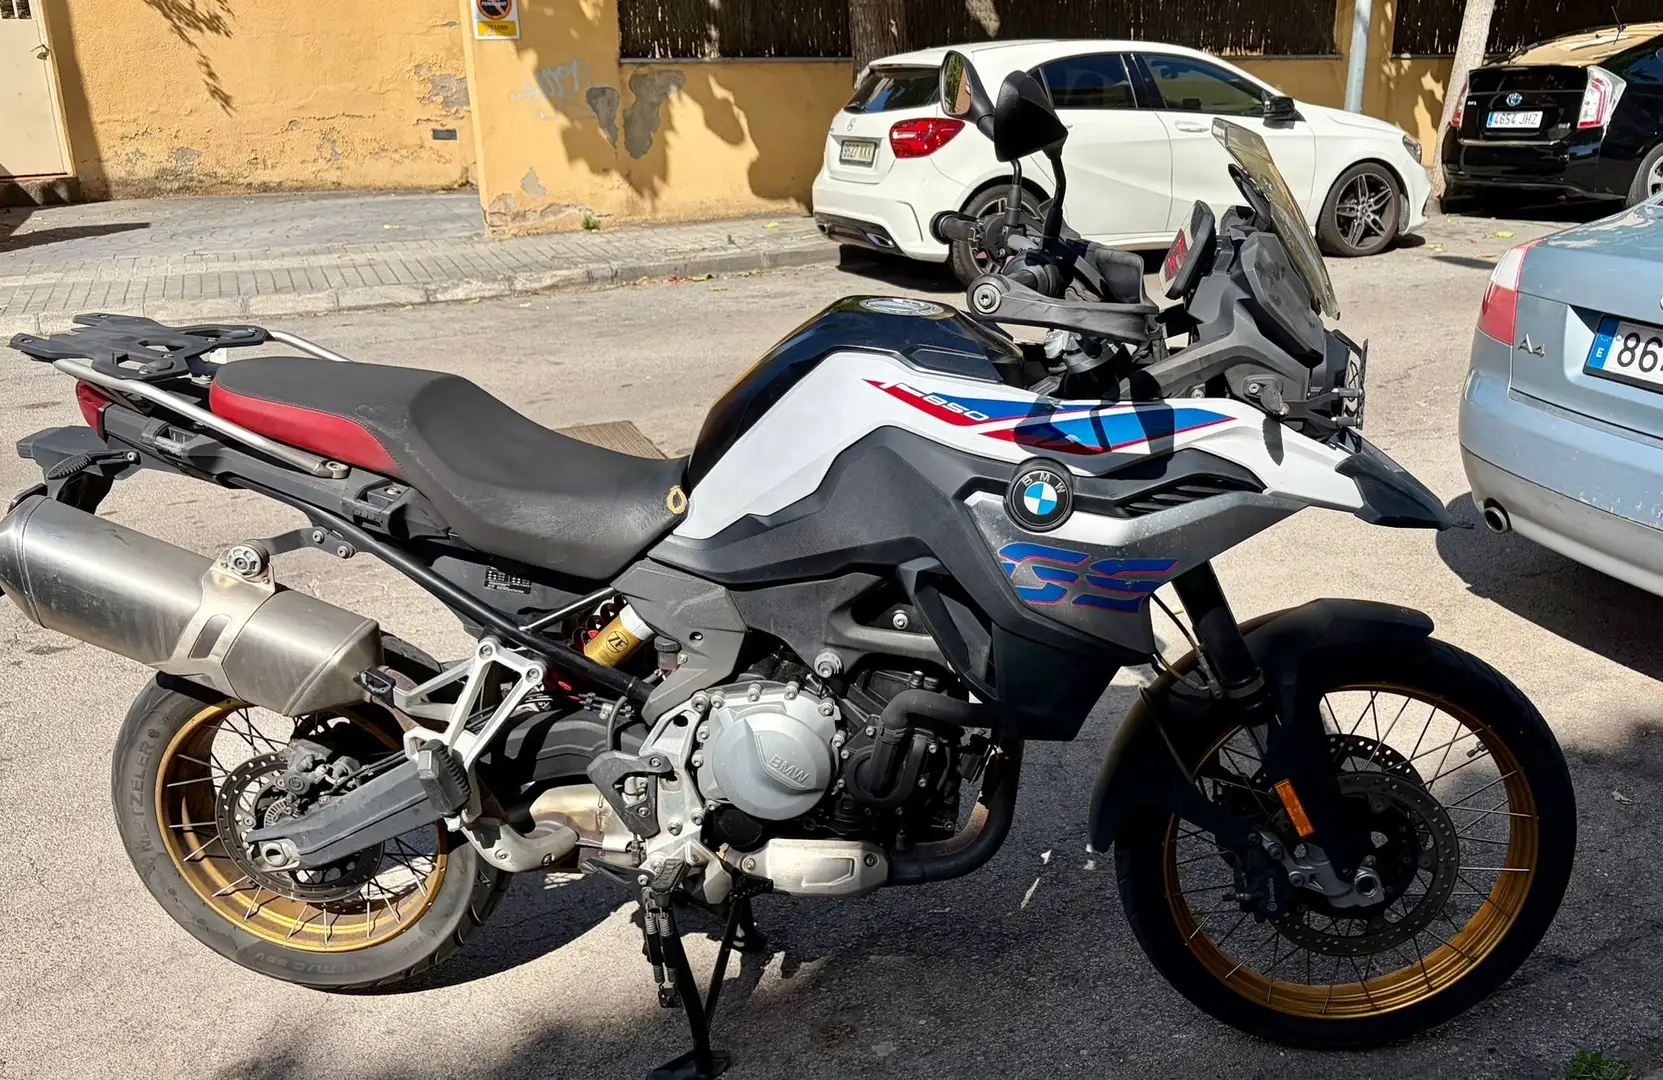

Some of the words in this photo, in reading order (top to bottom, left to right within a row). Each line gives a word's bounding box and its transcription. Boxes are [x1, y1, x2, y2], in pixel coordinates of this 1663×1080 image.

[1494, 112, 1516, 125] 4654
[1520, 112, 1539, 125] JHZ
[1518, 333, 1545, 358] A4
[1617, 332, 1663, 373] 86
[1021, 471, 1067, 493] BMW
[998, 542, 1179, 614] GS
[768, 753, 810, 783] BMW
[129, 741, 155, 851] METZELER
